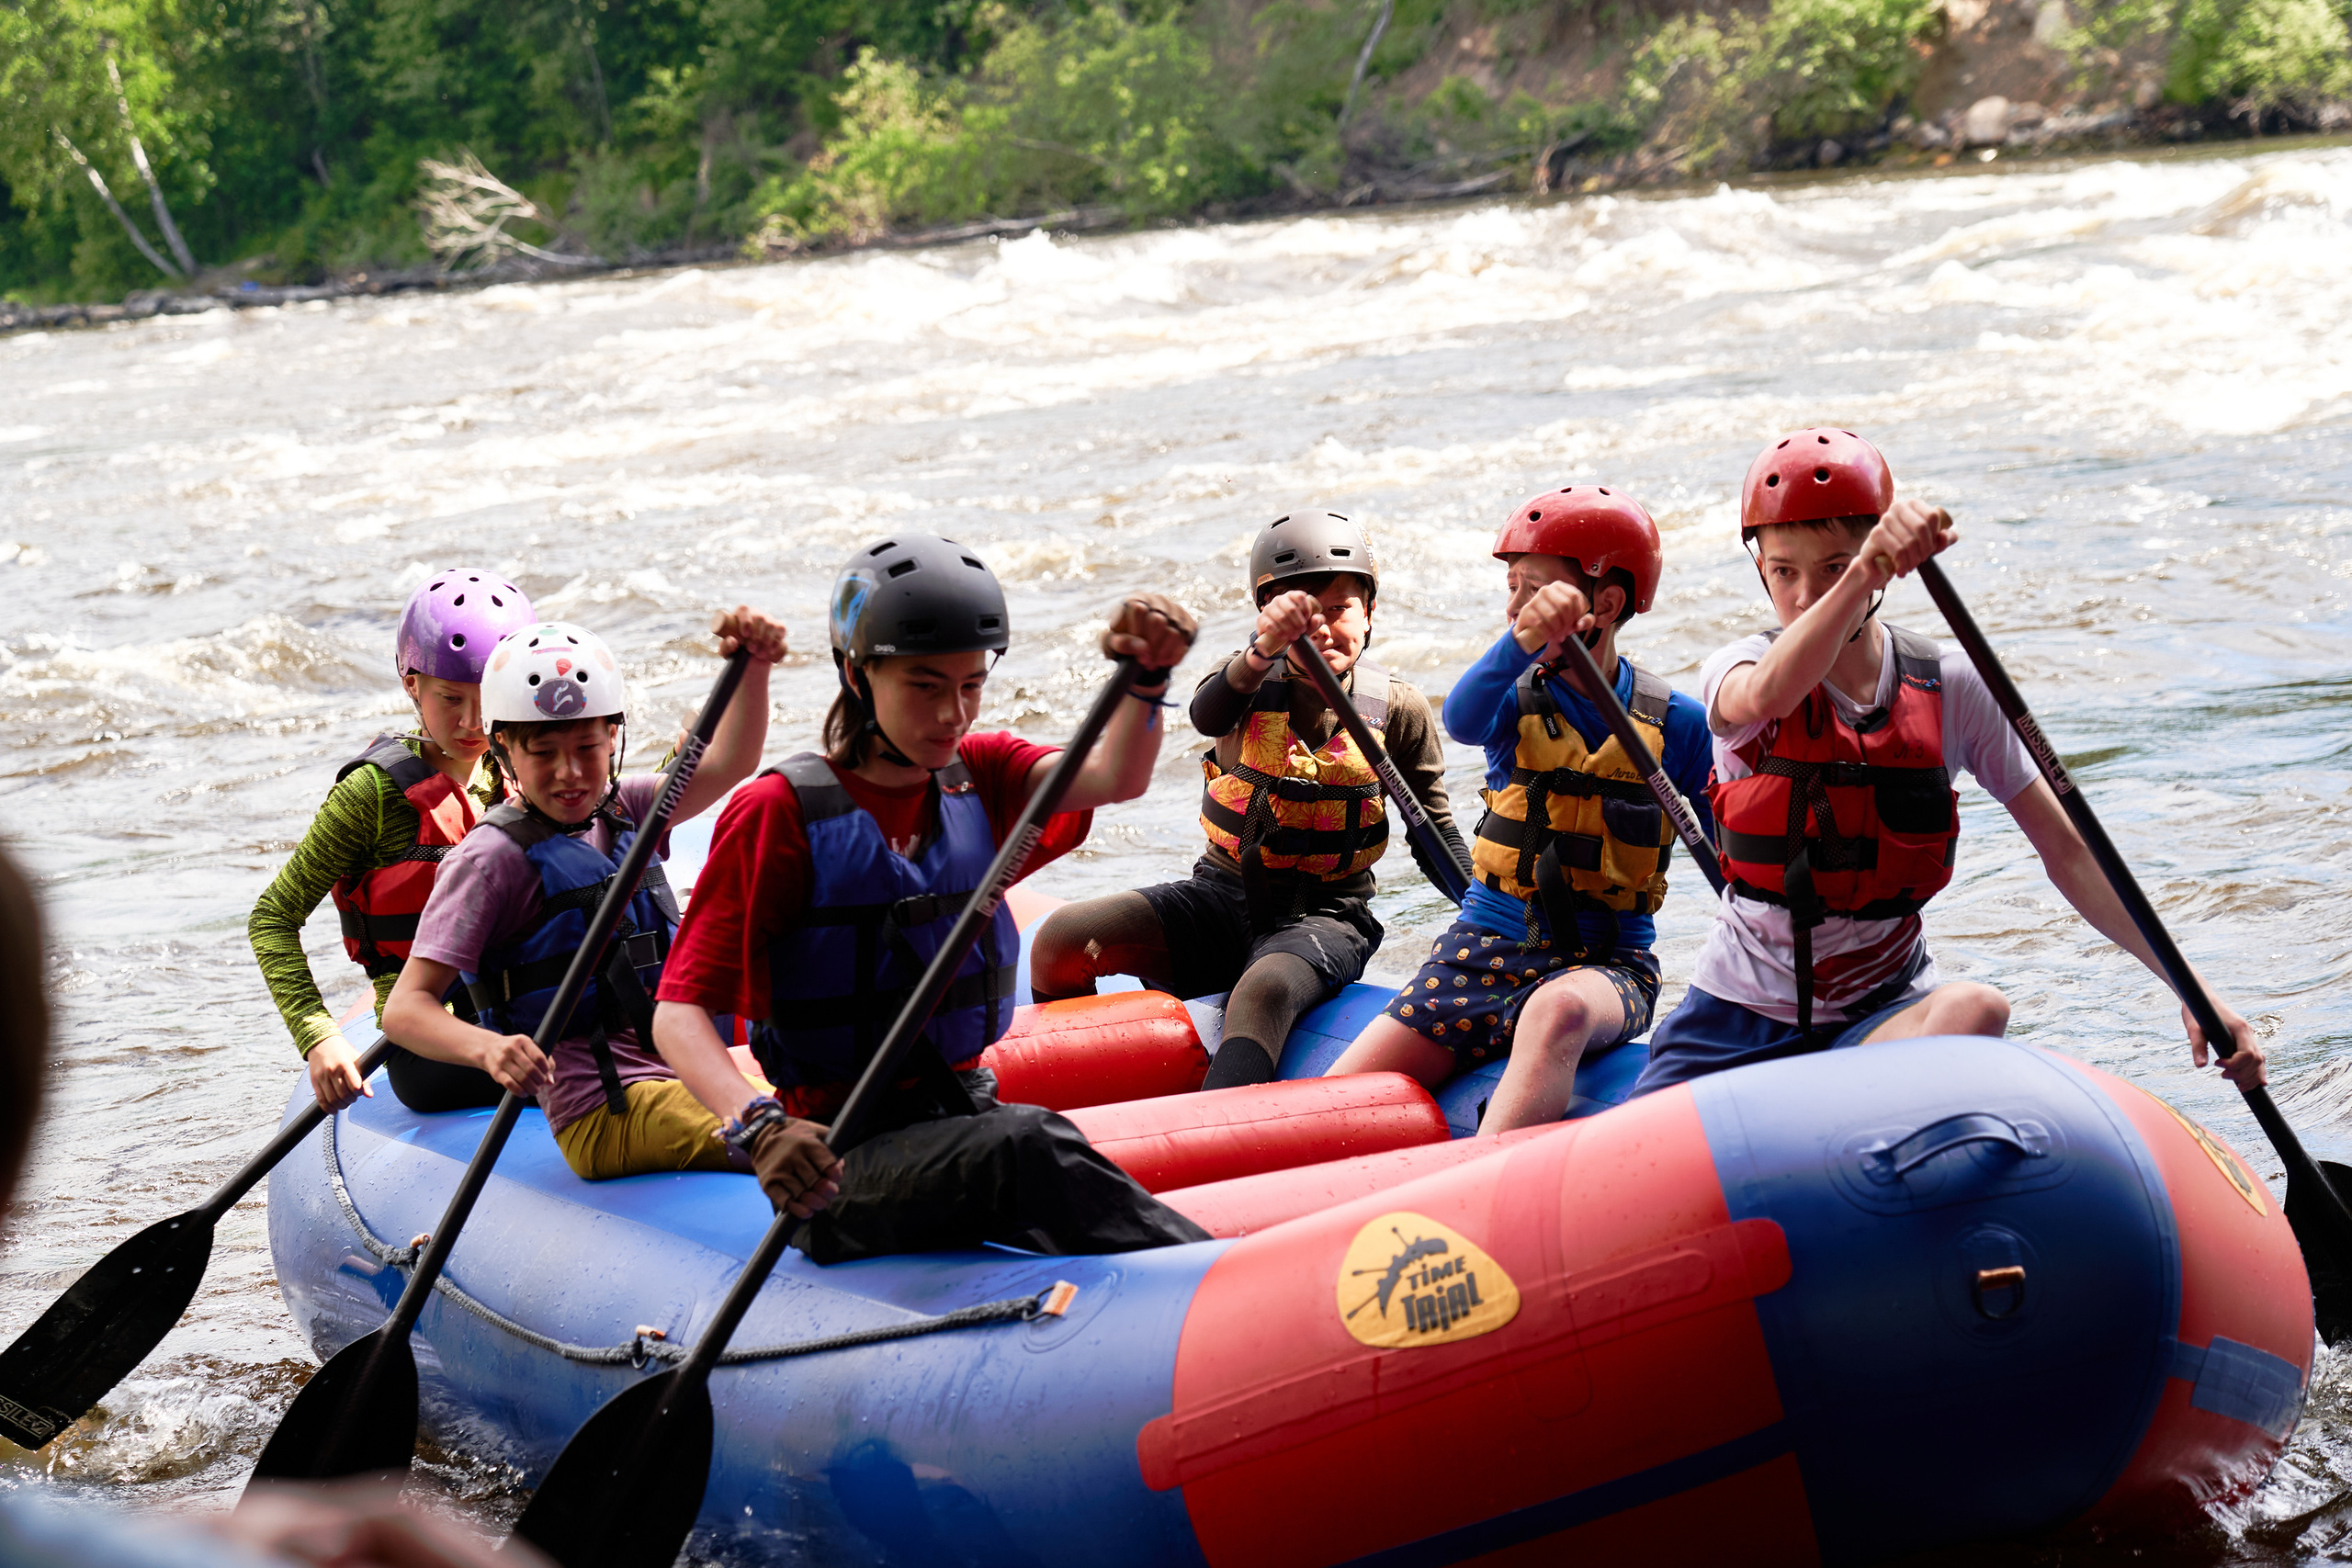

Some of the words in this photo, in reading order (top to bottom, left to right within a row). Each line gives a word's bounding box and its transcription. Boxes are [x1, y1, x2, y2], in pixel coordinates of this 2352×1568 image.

[2020, 713, 2064, 777] MISSILE
[657, 734, 708, 818] ДАНИИЛ
[1379, 759, 1419, 811] MISSILE
[1652, 772, 1694, 829] MISSILE
